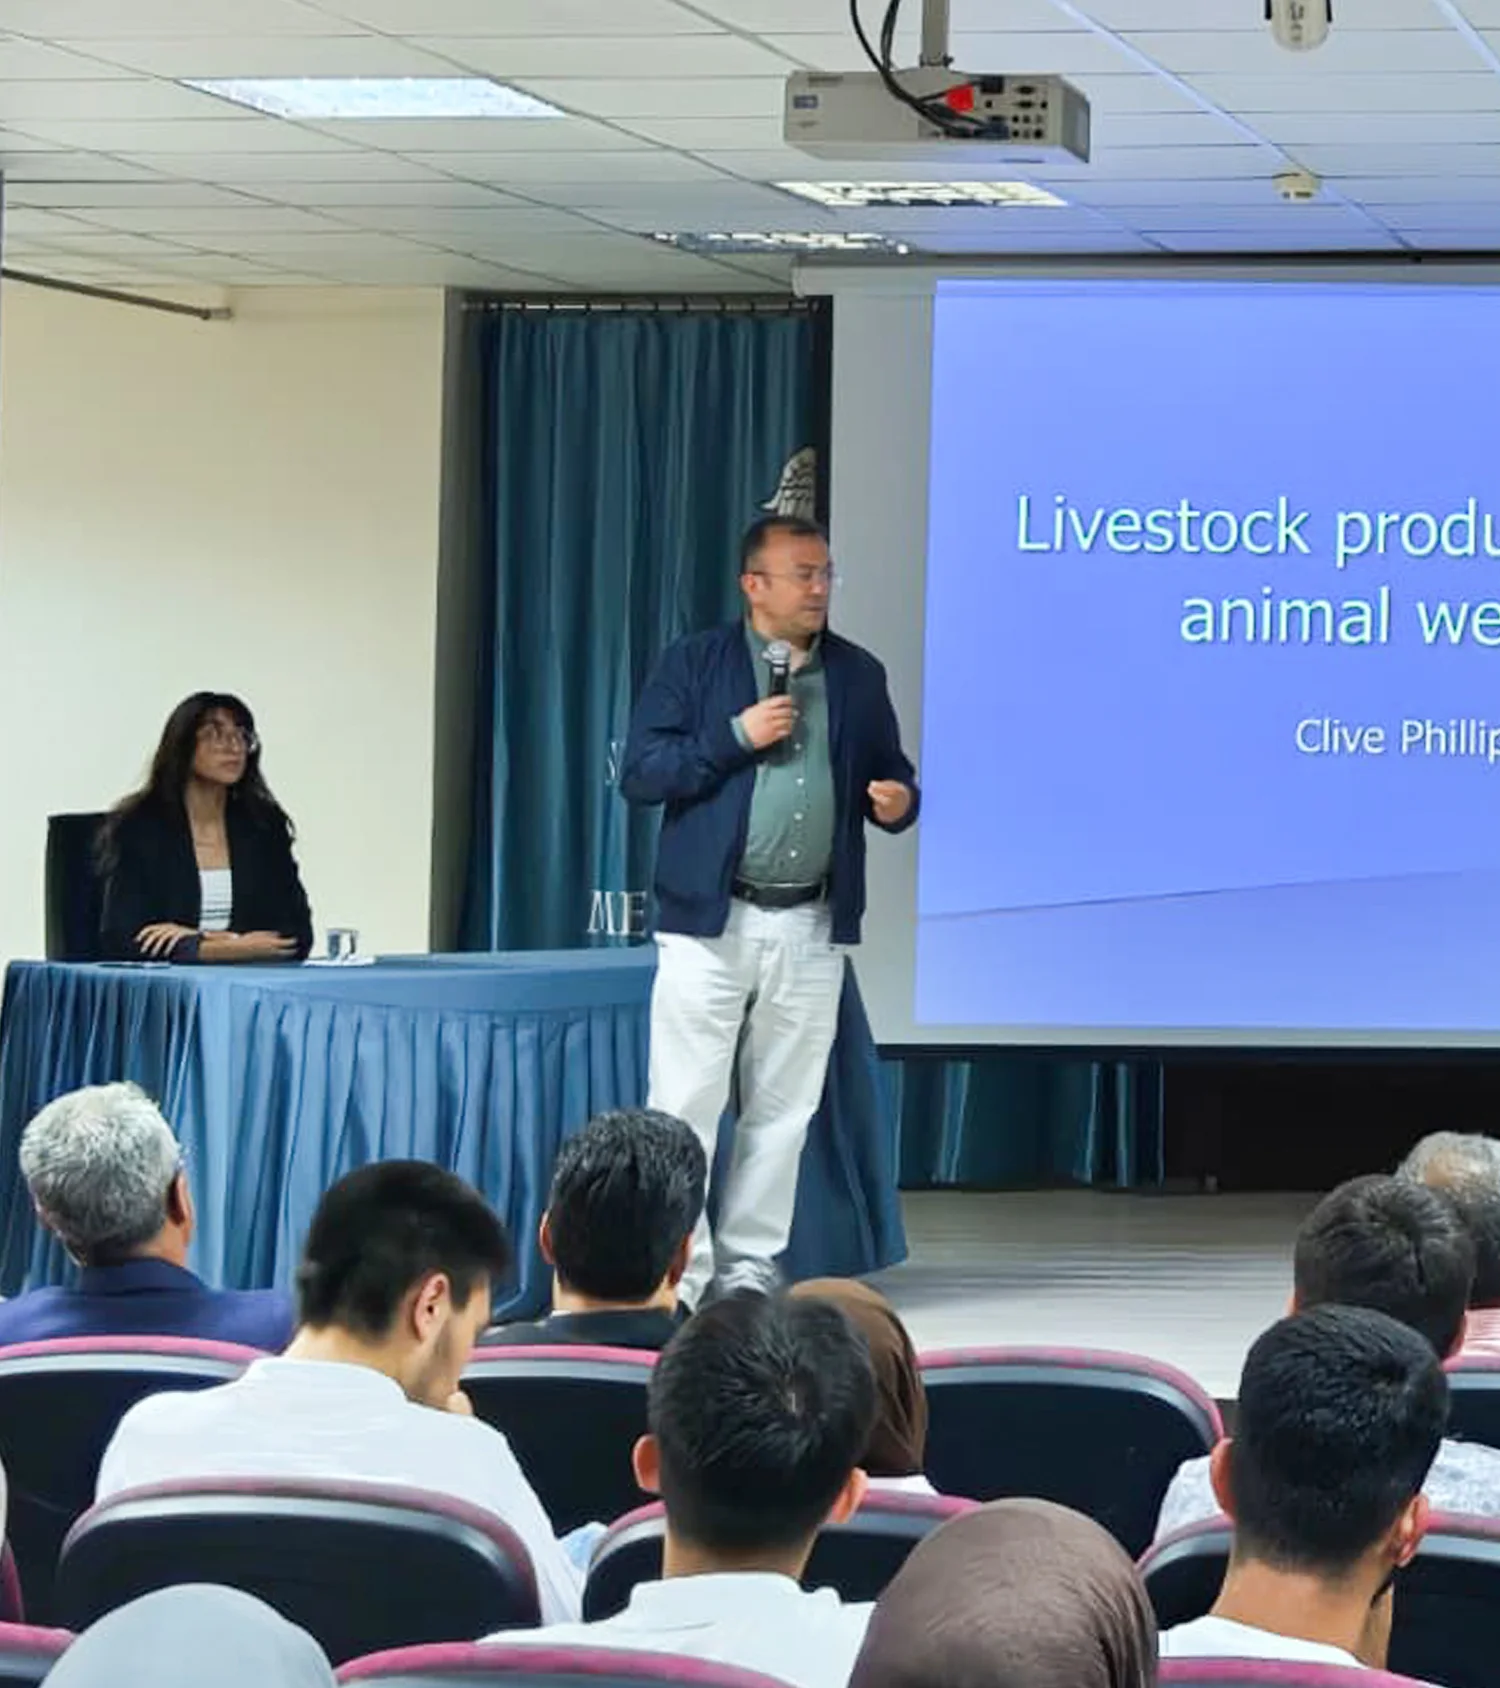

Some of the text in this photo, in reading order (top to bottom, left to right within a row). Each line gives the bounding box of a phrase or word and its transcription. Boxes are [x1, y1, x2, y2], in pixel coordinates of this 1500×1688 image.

[1017, 495, 1311, 555] Livestock
[1180, 585, 1389, 644] animal
[1295, 718, 1385, 754] Clive
